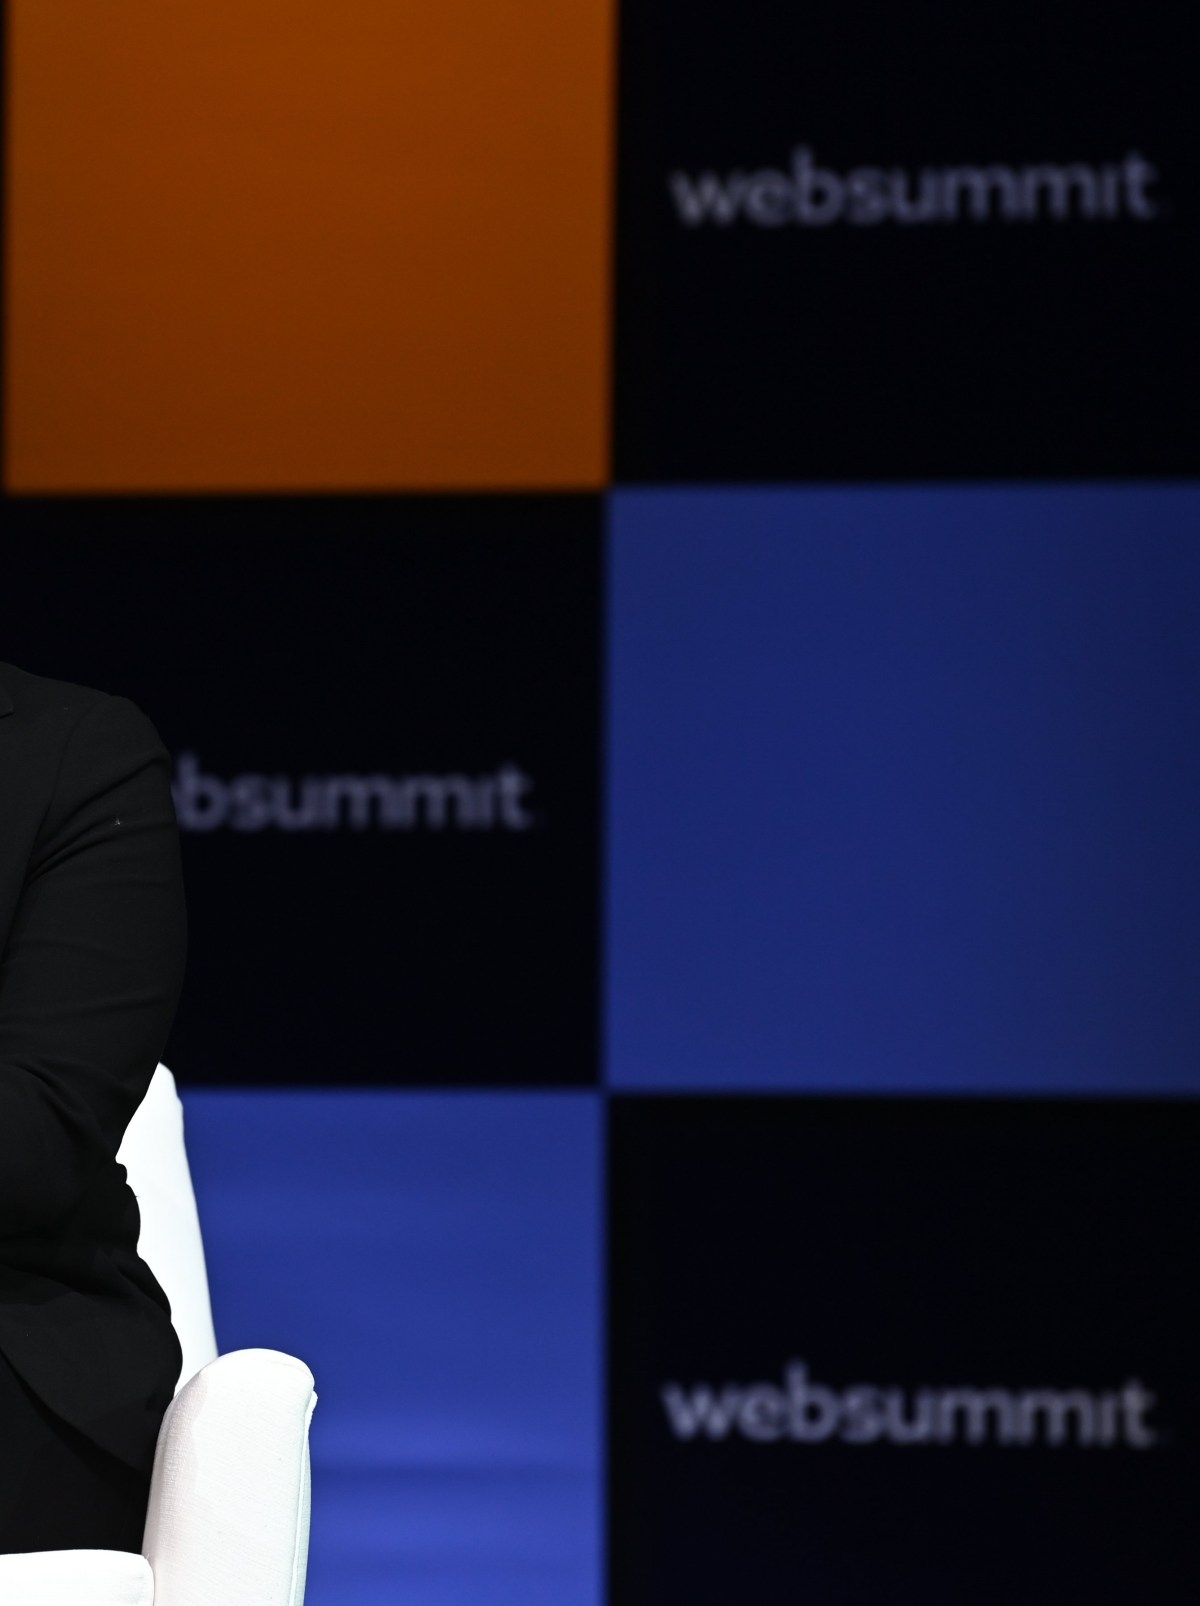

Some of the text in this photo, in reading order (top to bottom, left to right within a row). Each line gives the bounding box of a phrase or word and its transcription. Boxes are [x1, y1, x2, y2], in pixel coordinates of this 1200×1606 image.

[670, 146, 1155, 227] websummit
[170, 753, 533, 832] bsummit
[661, 1361, 1152, 1447] websummit
